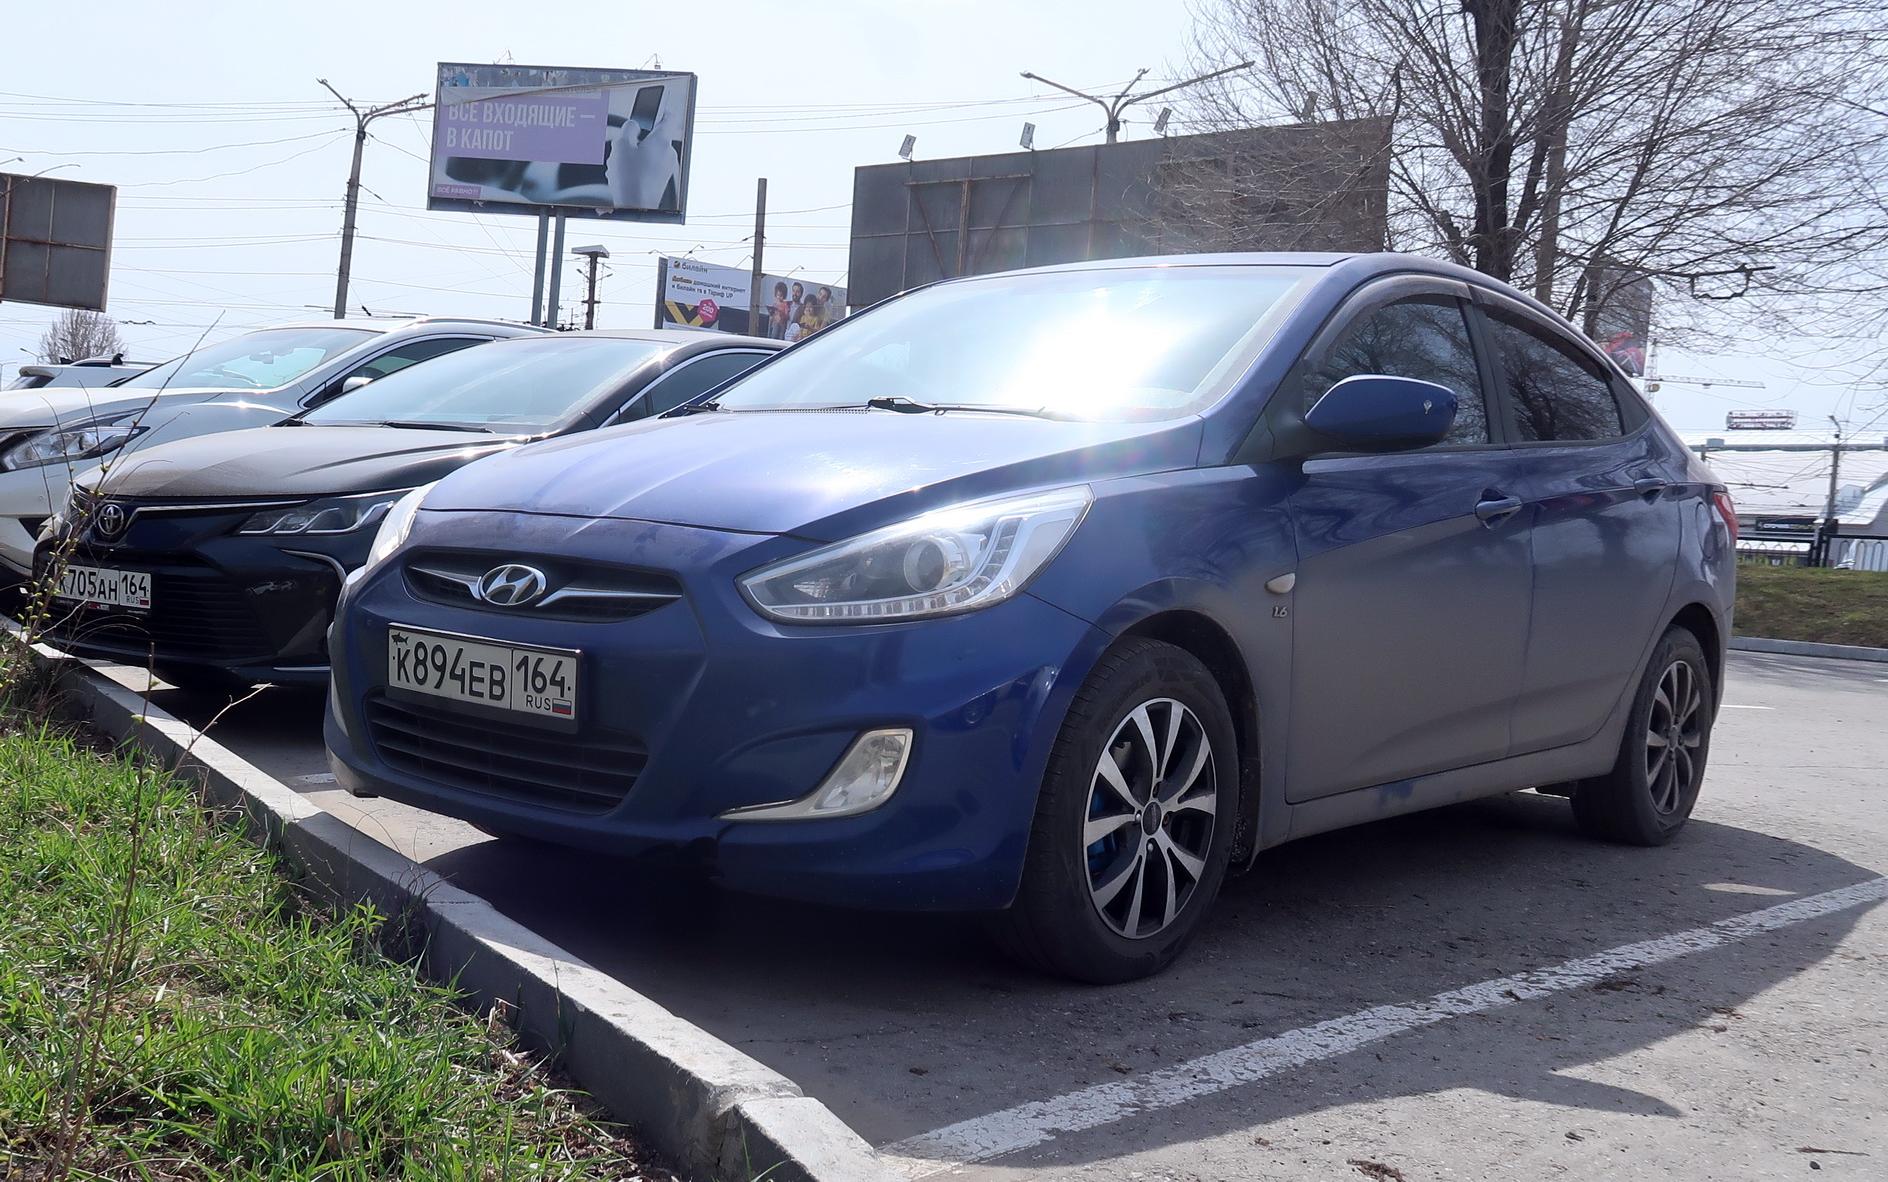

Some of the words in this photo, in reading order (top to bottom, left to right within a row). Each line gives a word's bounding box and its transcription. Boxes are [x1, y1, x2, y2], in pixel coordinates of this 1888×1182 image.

[483, 101, 577, 128] ВХОДЯЩИЕ
[446, 127, 457, 148] В
[461, 128, 514, 151] КАПОТ
[682, 261, 708, 274] билайн
[121, 574, 147, 597] 164
[126, 595, 140, 605] RUS
[397, 641, 506, 700] К894ЕВ
[515, 655, 566, 698] 164
[526, 694, 551, 711] RUS
